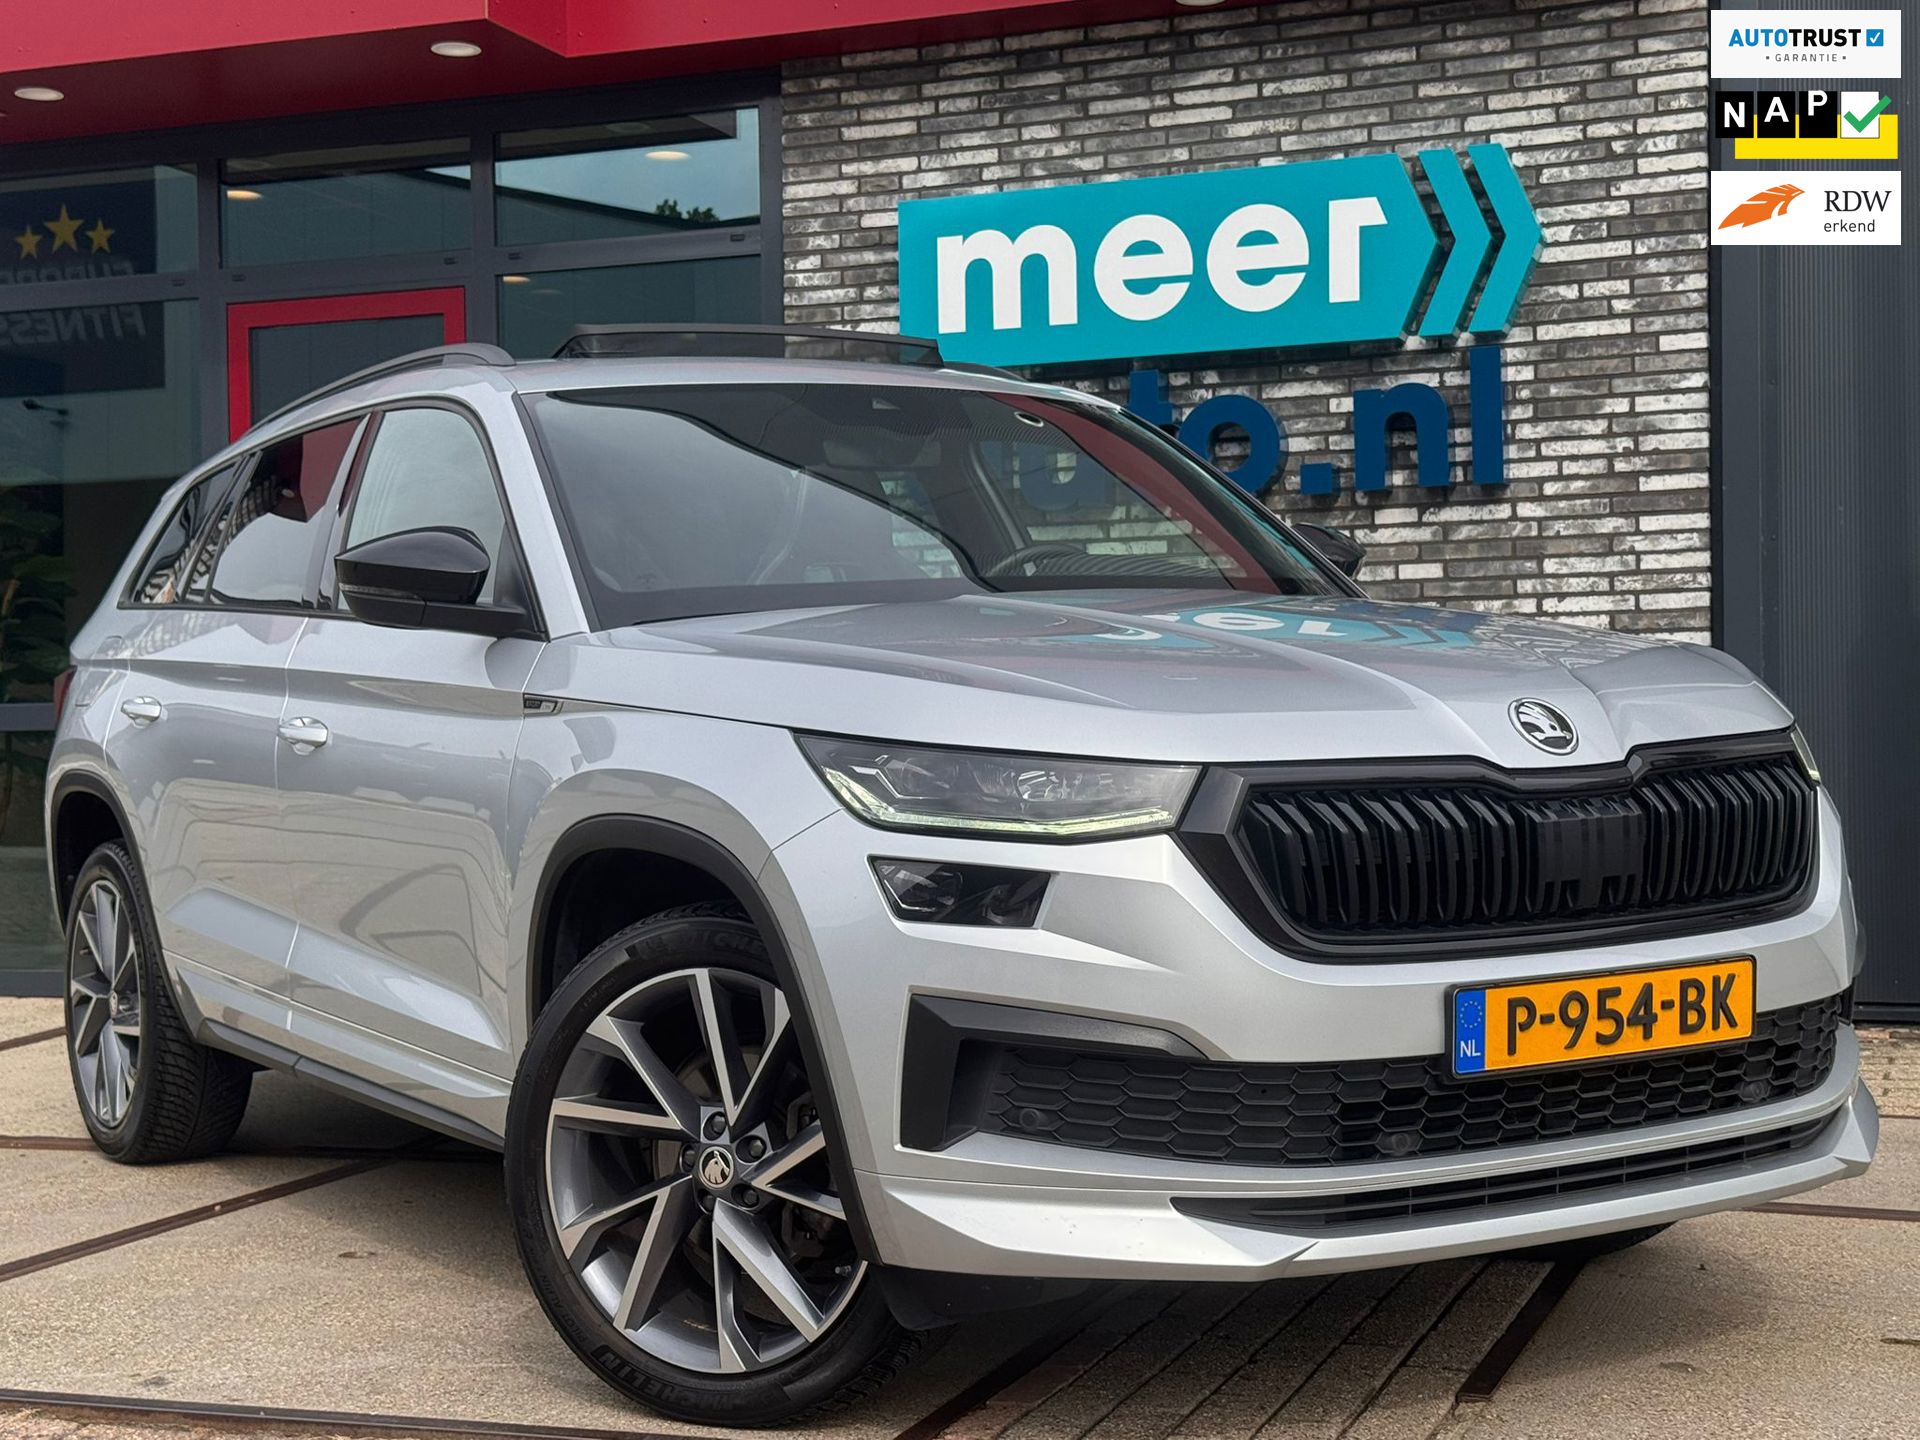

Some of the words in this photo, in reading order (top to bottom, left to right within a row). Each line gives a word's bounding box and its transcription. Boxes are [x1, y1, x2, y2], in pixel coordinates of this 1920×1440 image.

[936, 196, 1388, 334] meer
[1460, 1039, 1481, 1058] NL
[1507, 973, 1738, 1056] P-954-BK
